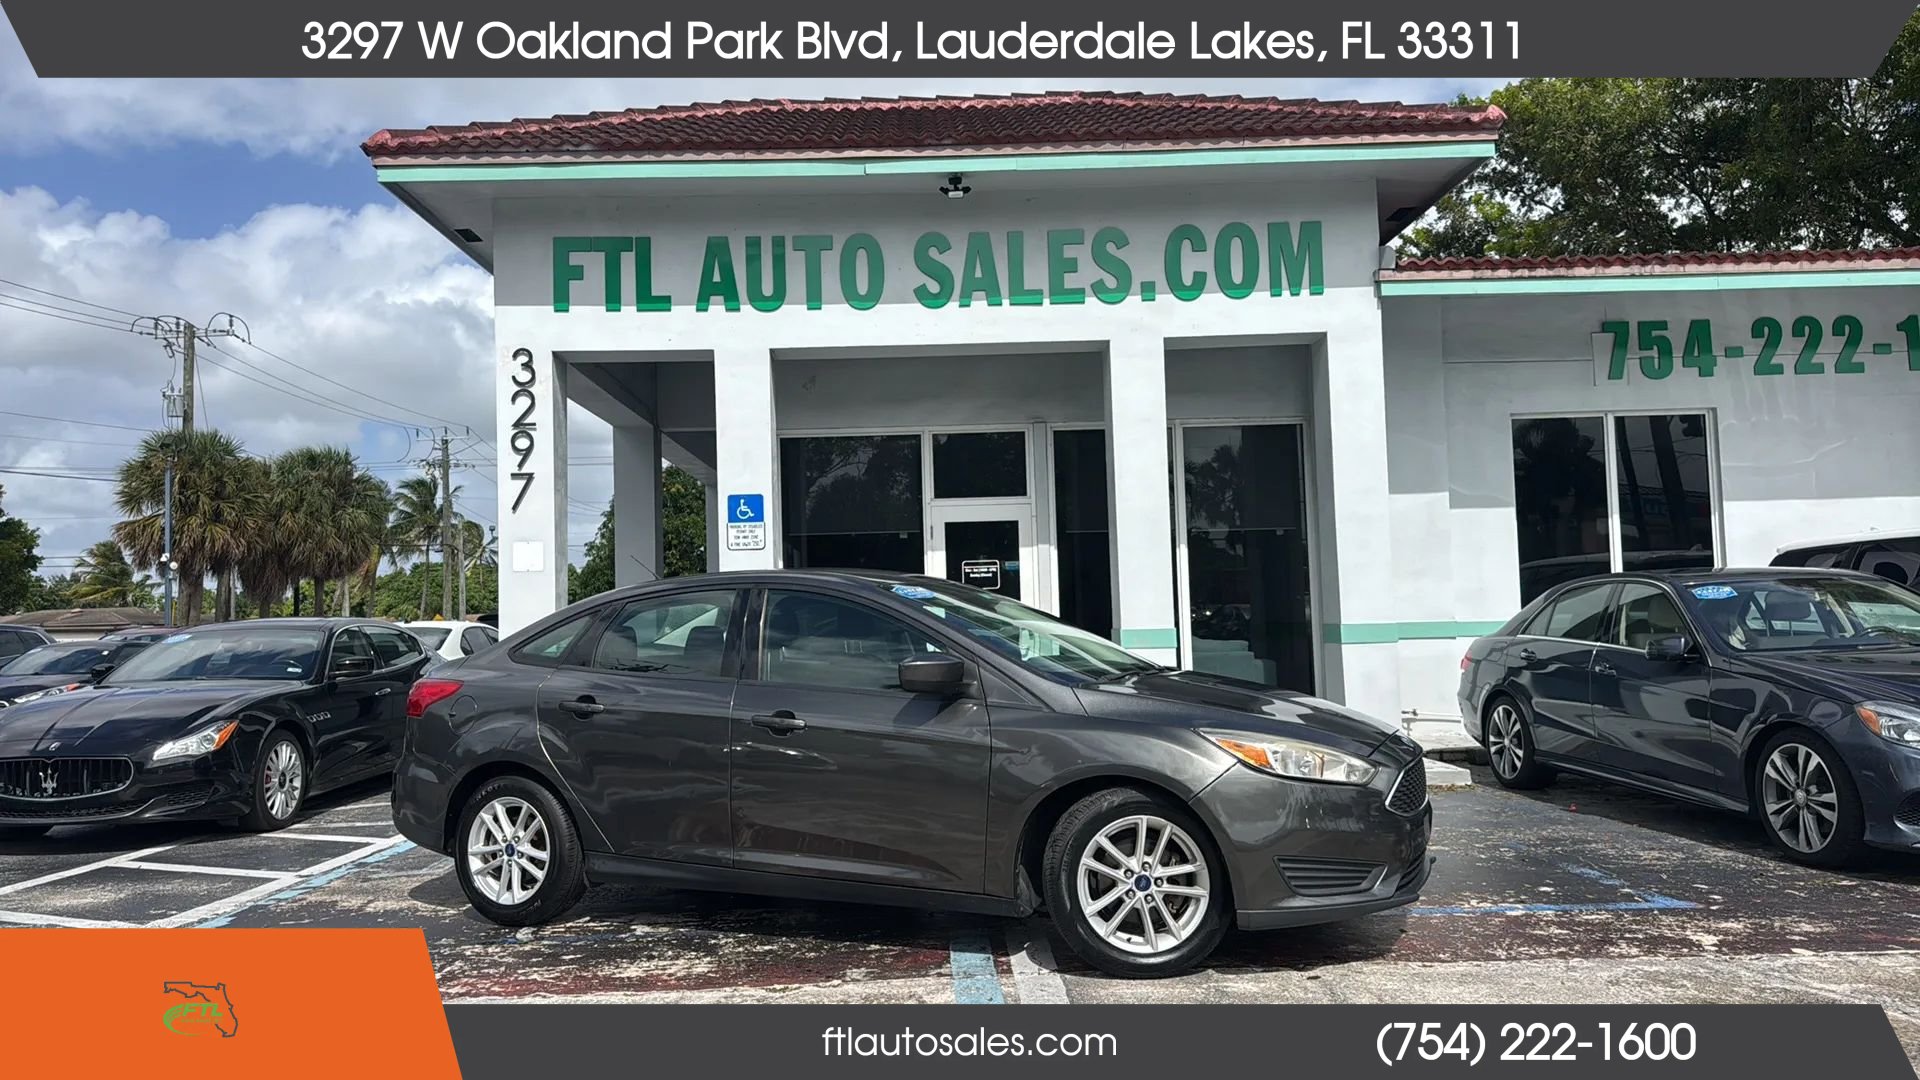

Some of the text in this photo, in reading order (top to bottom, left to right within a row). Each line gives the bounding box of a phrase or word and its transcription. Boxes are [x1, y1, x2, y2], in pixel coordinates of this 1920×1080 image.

[553, 220, 1324, 313] FTL AUTO SALES.COM
[511, 347, 537, 513] 3297
